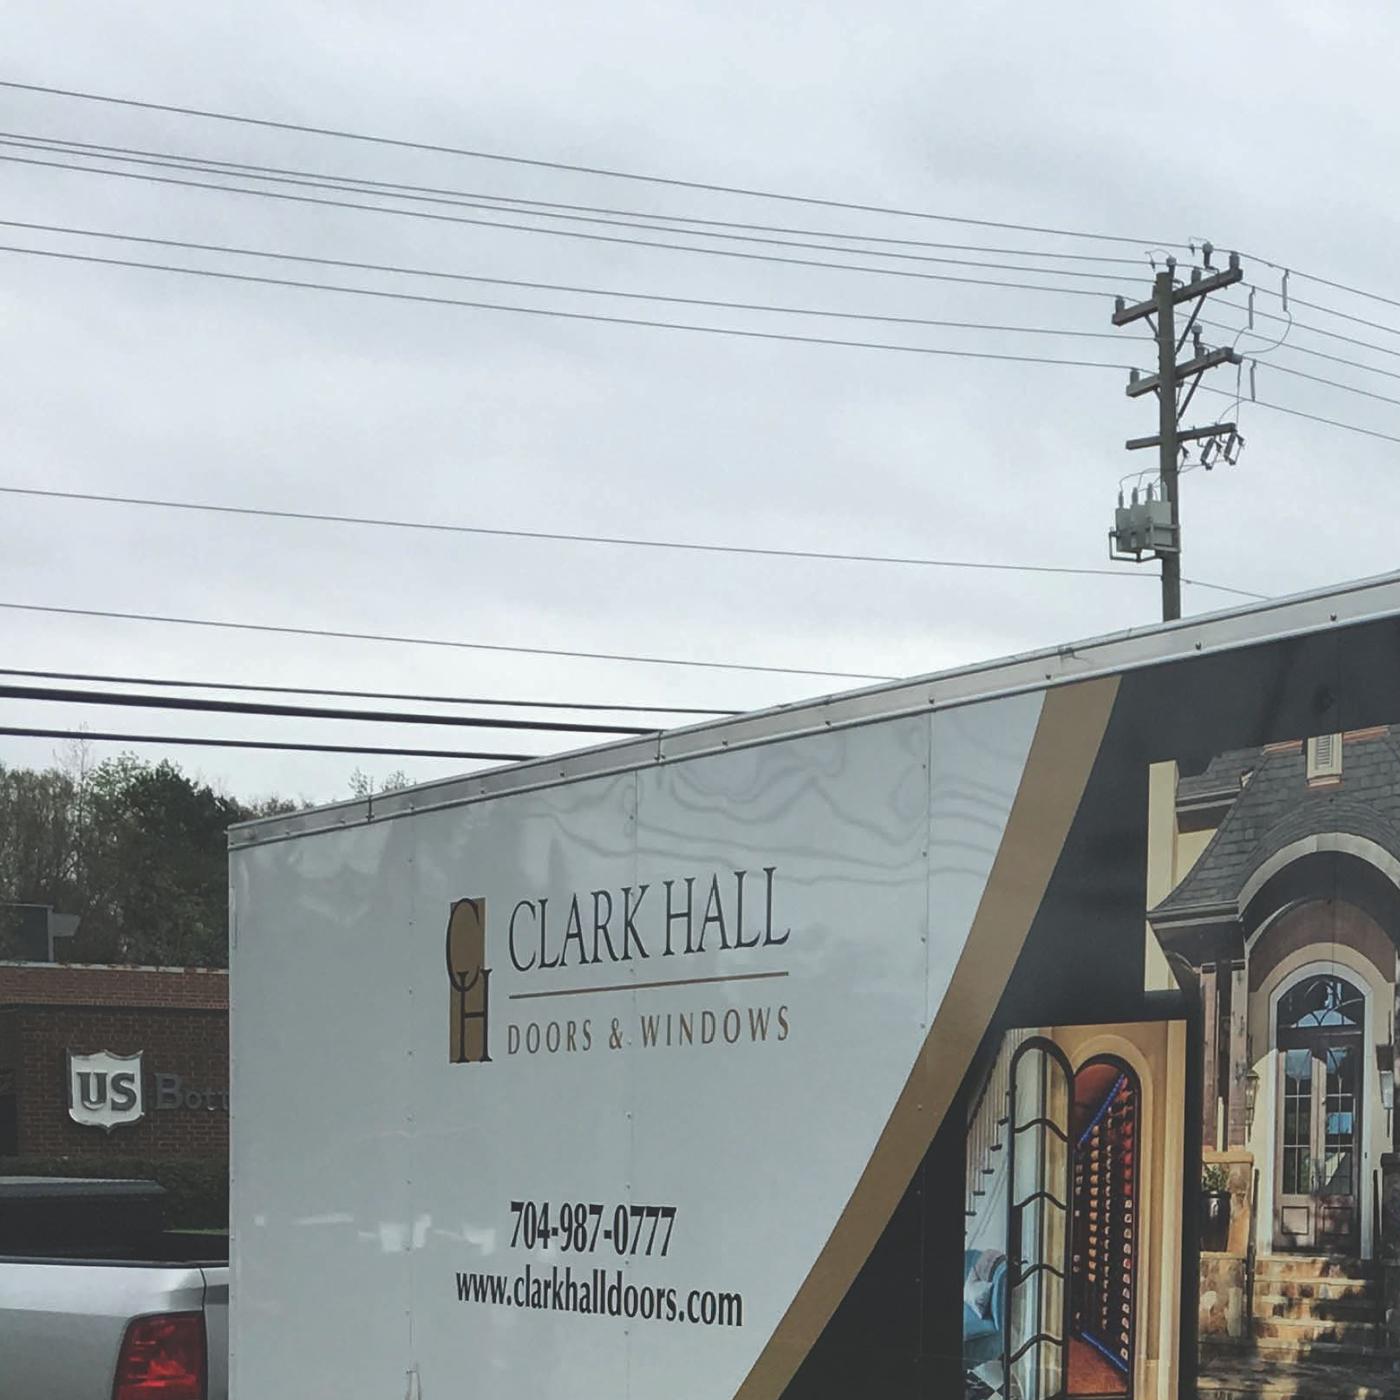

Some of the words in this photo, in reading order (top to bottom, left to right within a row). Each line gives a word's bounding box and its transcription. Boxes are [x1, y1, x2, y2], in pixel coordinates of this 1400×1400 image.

[509, 884, 650, 972] CLARK
[663, 867, 791, 956] HALL
[508, 1019, 592, 1054] DOORS
[609, 1017, 623, 1050] &
[641, 1005, 789, 1047] WINDOWS
[76, 1072, 137, 1112] US
[510, 1201, 677, 1256] 704-987-0777
[456, 1264, 743, 1326] www.clarkhalldoors.com
